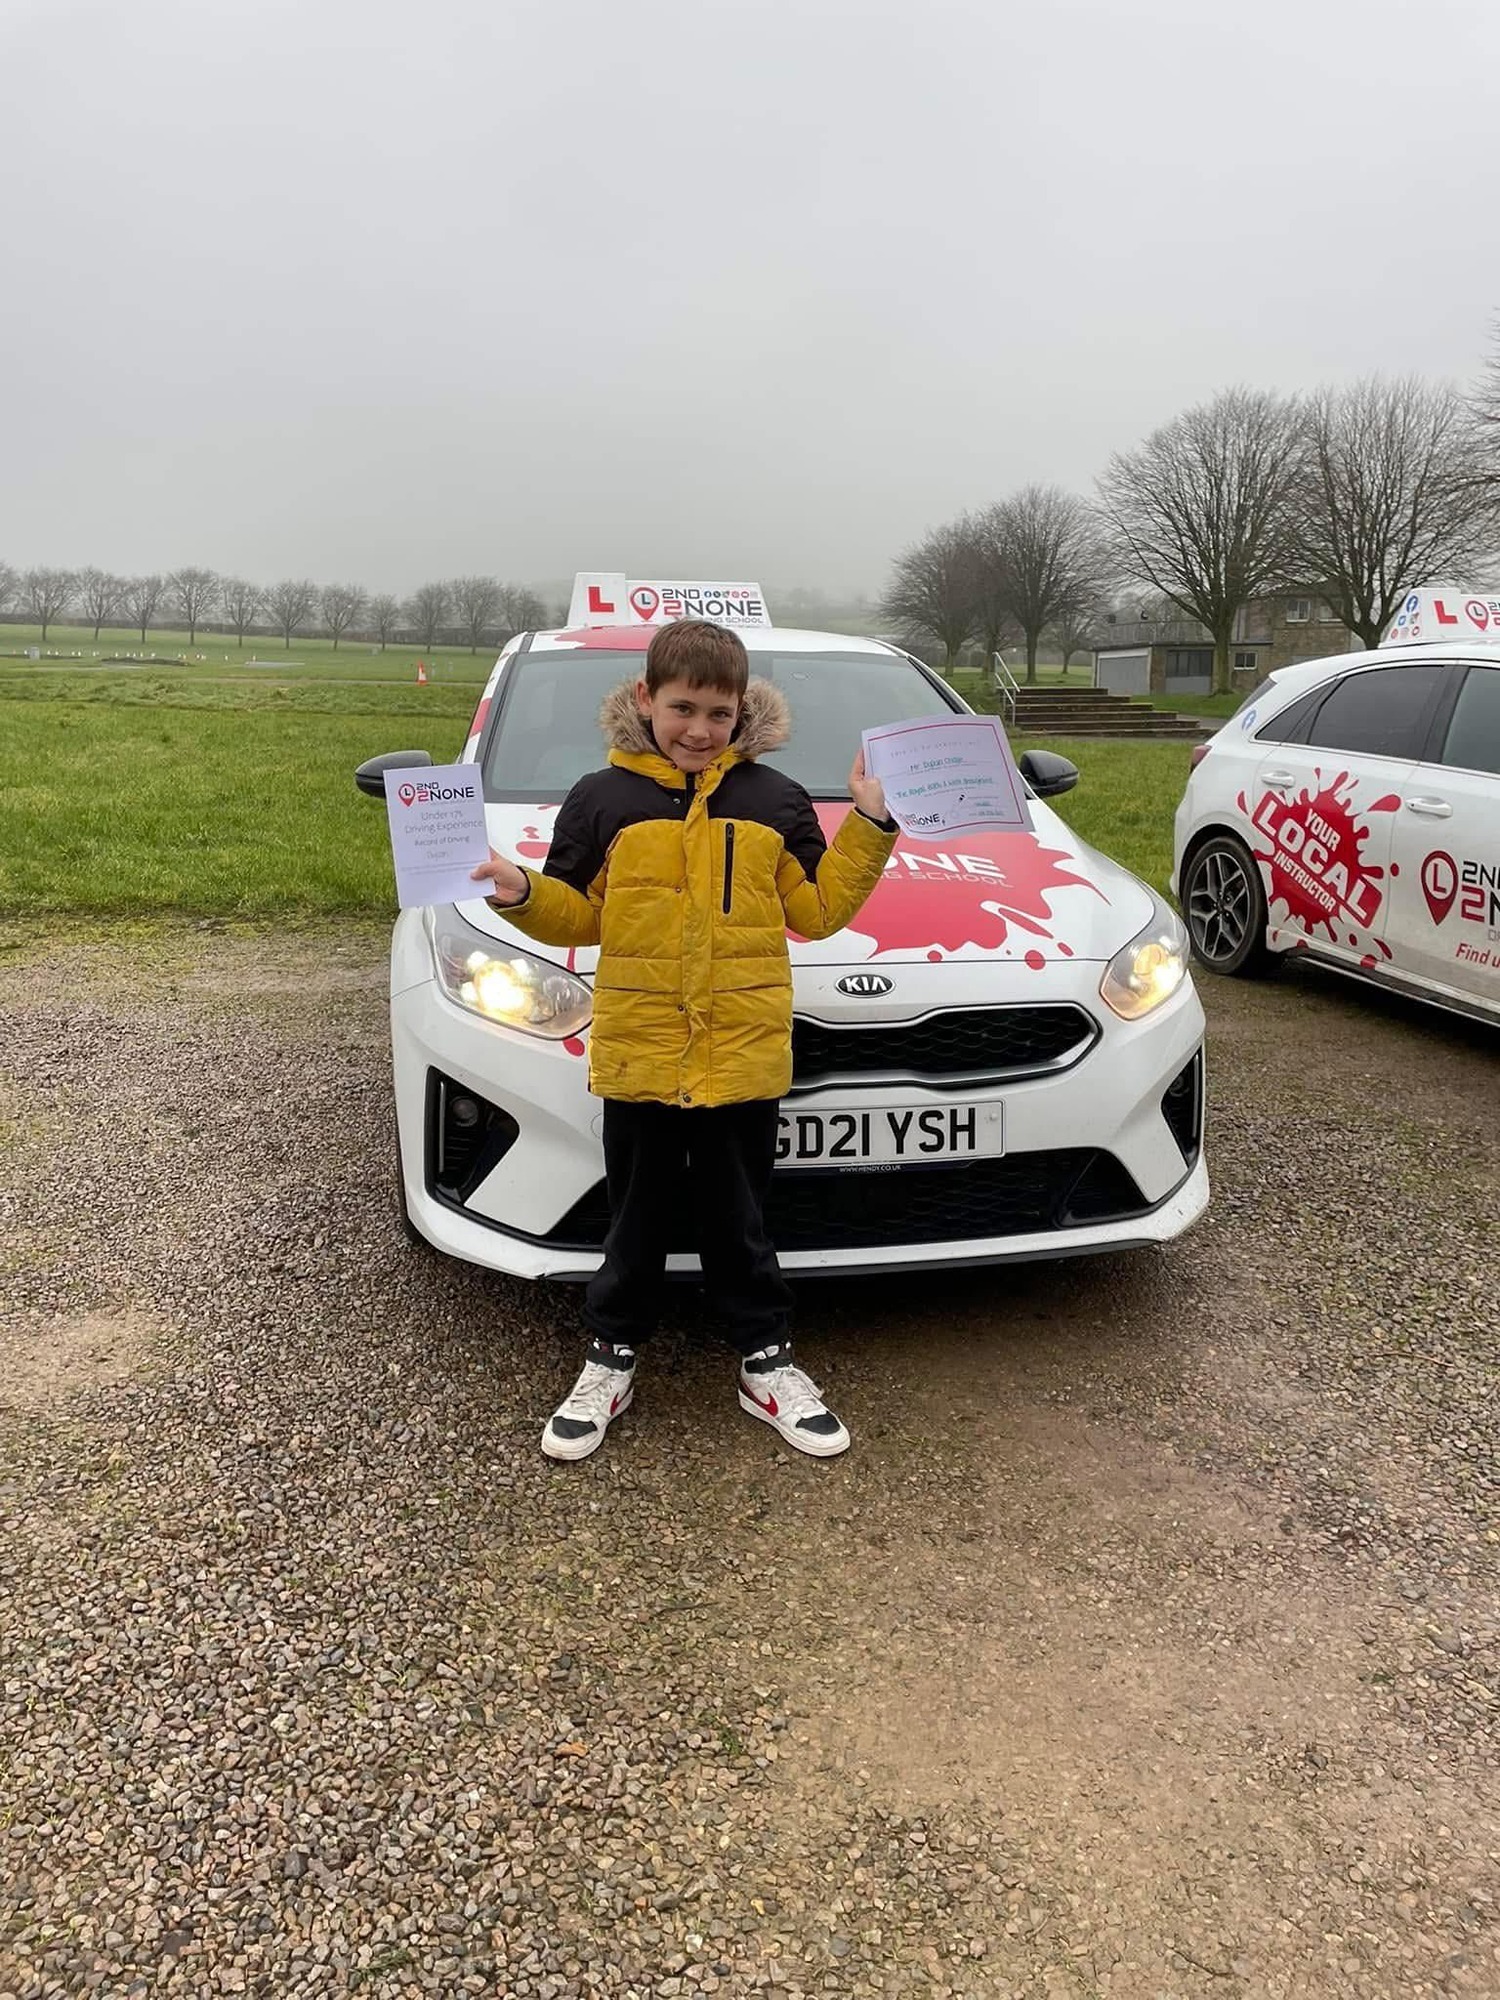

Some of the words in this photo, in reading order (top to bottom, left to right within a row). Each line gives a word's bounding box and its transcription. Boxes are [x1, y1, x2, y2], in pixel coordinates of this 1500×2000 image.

[588, 586, 615, 613] L
[661, 588, 700, 599] 2ND
[663, 600, 763, 616] 2NONE
[1433, 600, 1458, 624] L
[416, 782, 439, 791] 2ND
[417, 787, 475, 802] 2NONE
[1304, 809, 1341, 851] YOUR
[1257, 801, 1368, 920] LOCAL
[909, 871, 1015, 889] SCHOOL
[1273, 850, 1337, 913] INSTRUCTOR
[1432, 863, 1447, 894] L
[1462, 860, 1500, 889] 2N
[1456, 943, 1491, 965] Find
[843, 976, 889, 992] KIA
[775, 1112, 870, 1160] GD21
[887, 1107, 976, 1155] YSH
